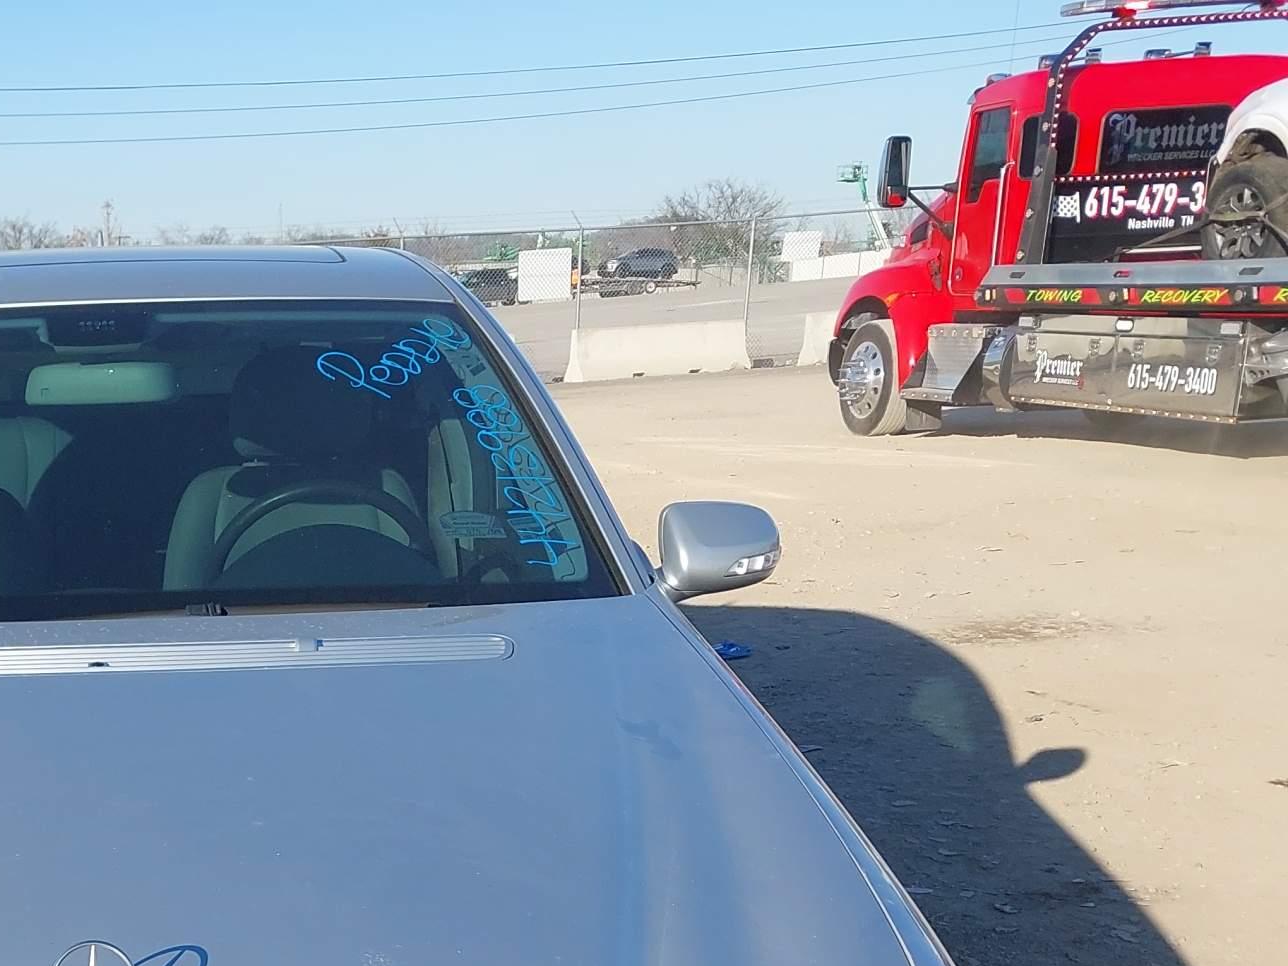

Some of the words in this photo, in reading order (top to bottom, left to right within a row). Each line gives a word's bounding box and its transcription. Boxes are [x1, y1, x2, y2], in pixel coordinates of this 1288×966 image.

[1109, 113, 1224, 163] Premier
[1163, 150, 1199, 160] SERVICES
[1085, 181, 1207, 218] 615-479-3
[1127, 217, 1175, 230] Nashville
[1181, 215, 1195, 226] TN
[1025, 289, 1082, 302] TOWING
[1141, 289, 1228, 303] RECOVERY
[1034, 350, 1083, 383] Premier
[1127, 363, 1217, 395] 615-479-3400
